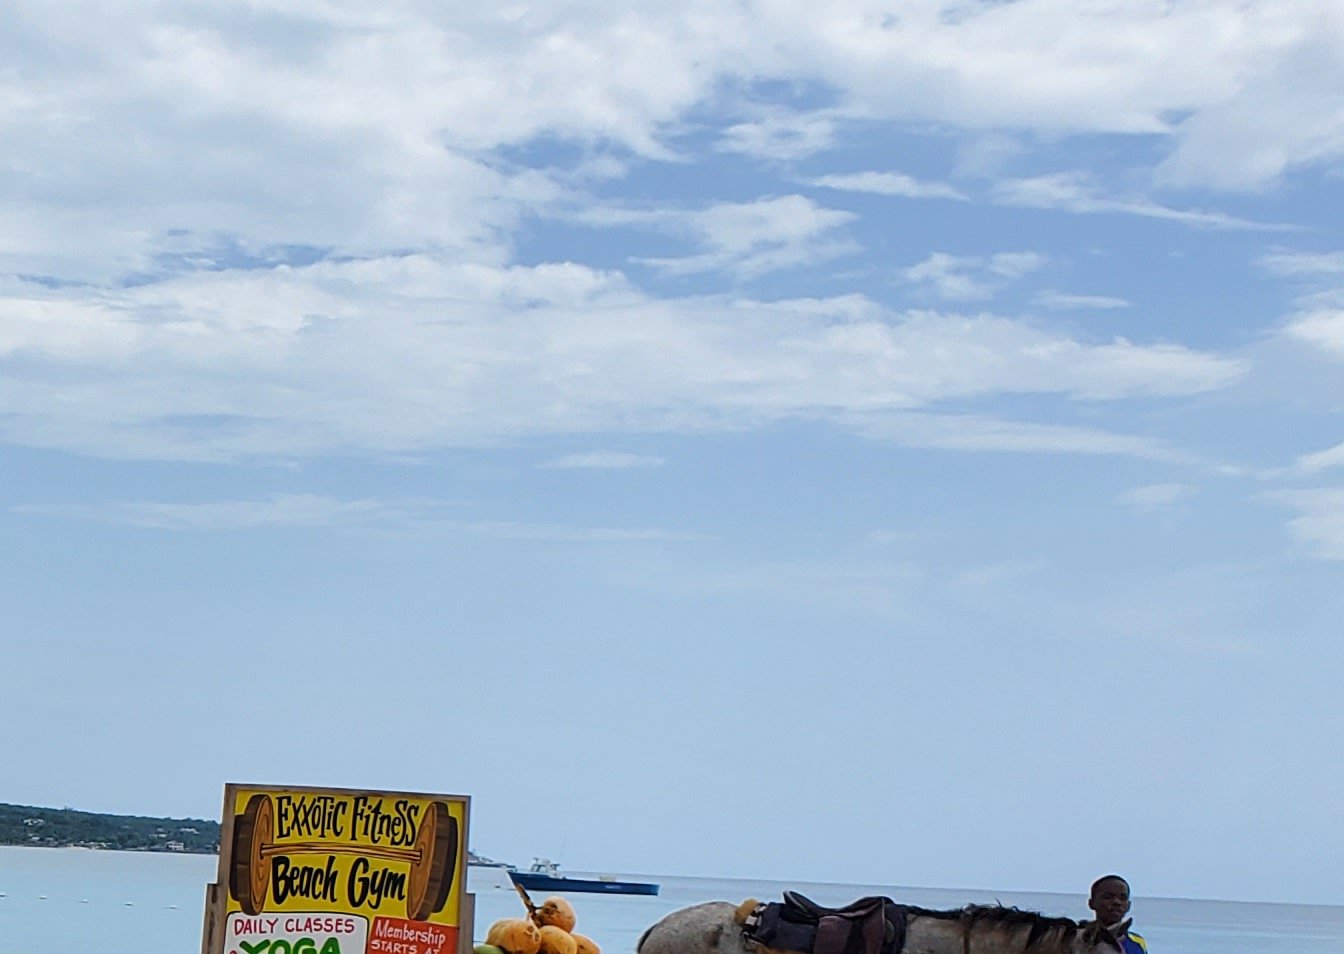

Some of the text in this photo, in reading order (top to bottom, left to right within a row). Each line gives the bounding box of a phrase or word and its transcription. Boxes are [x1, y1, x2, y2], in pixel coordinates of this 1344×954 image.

[272, 856, 405, 909] Beach Gym
[235, 918, 354, 935] DAILY CLASSES
[376, 920, 446, 949] Membership
[371, 940, 417, 954] STARTS
